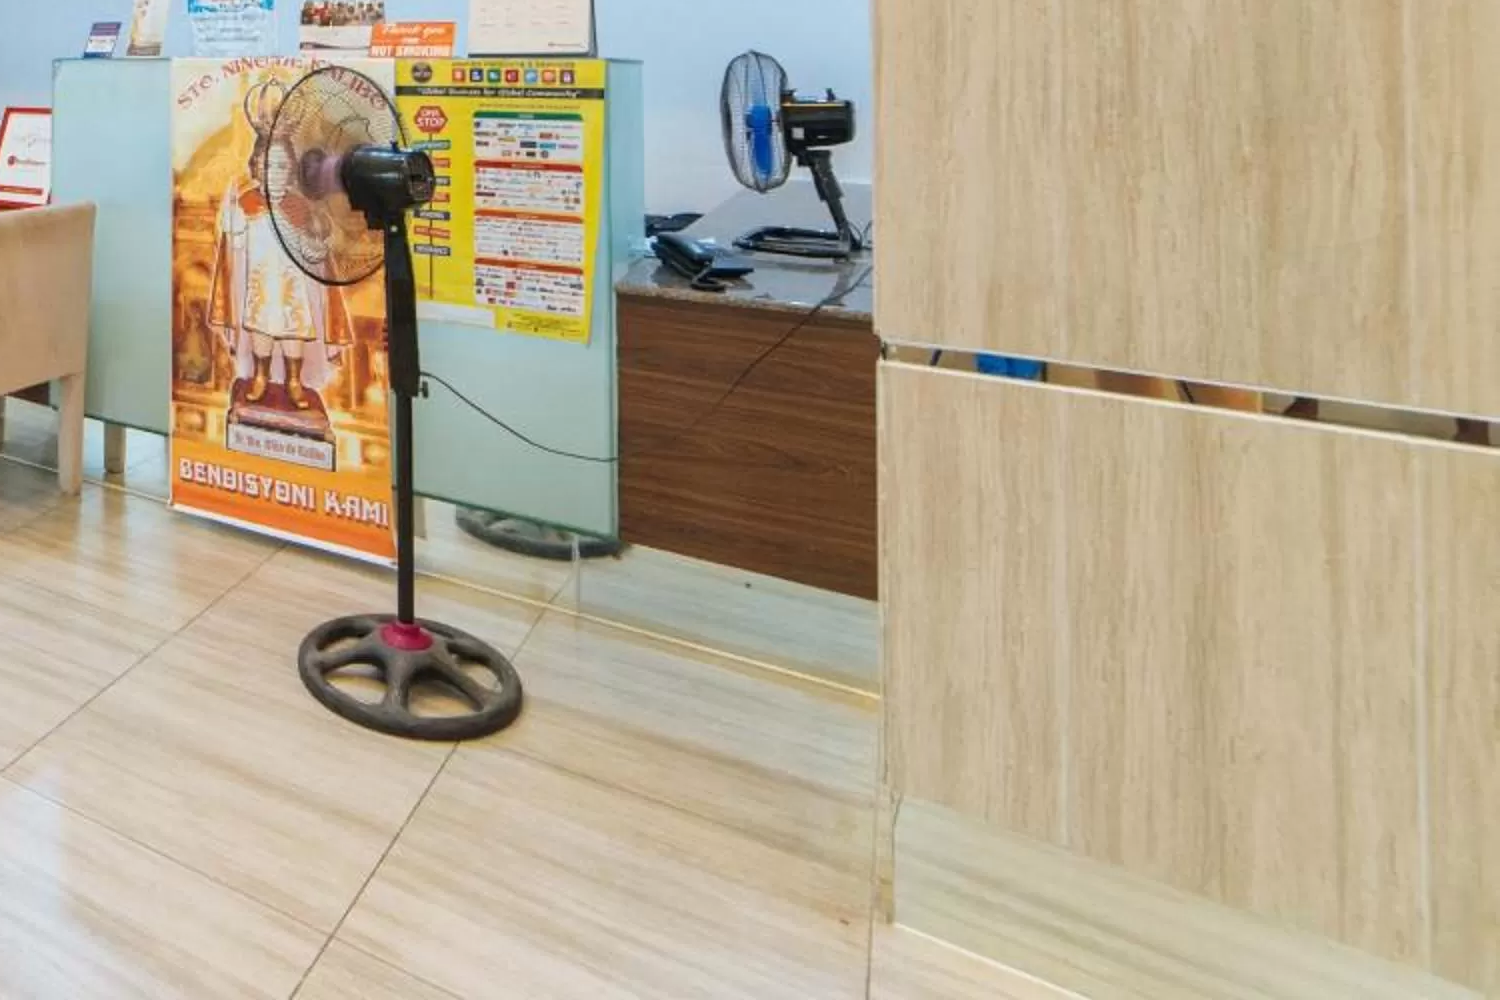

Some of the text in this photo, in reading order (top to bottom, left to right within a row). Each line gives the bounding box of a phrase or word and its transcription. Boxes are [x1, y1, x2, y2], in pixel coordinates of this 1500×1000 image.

[371, 45, 393, 57] NOT
[416, 116, 445, 127] STOP
[179, 457, 389, 526] BENDISYONI KAMI
